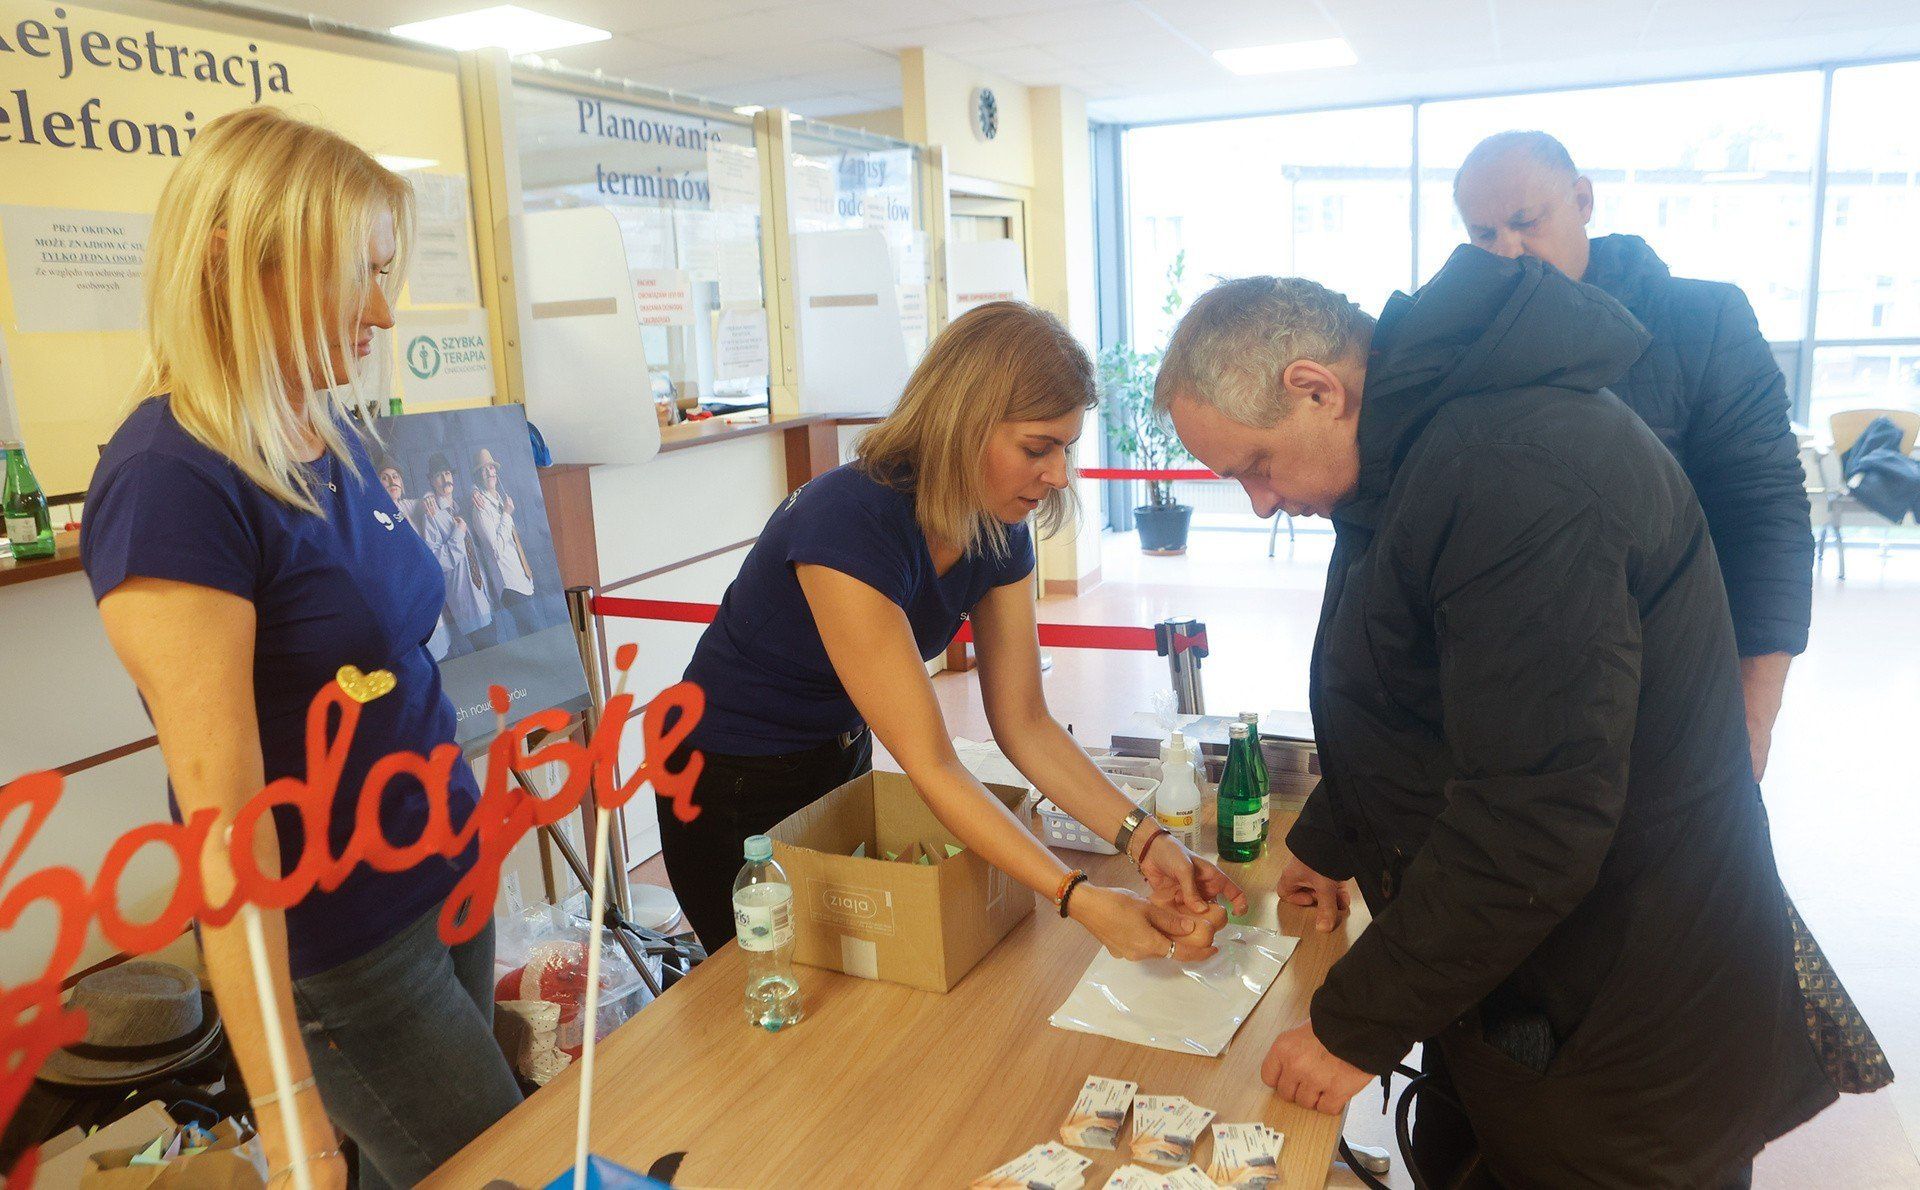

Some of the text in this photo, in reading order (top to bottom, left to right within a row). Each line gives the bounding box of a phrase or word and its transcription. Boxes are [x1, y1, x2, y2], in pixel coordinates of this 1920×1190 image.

[0, 7, 293, 104] ejestracja
[596, 163, 710, 203] terminów
[53, 224, 125, 236] PRZY OKIENKU
[35, 238, 65, 248] MOŻE
[41, 252, 77, 262] TYLKO
[79, 253, 110, 263] JEDNA
[442, 336, 484, 349] SZYBKA
[443, 351, 486, 364] TERAPIA
